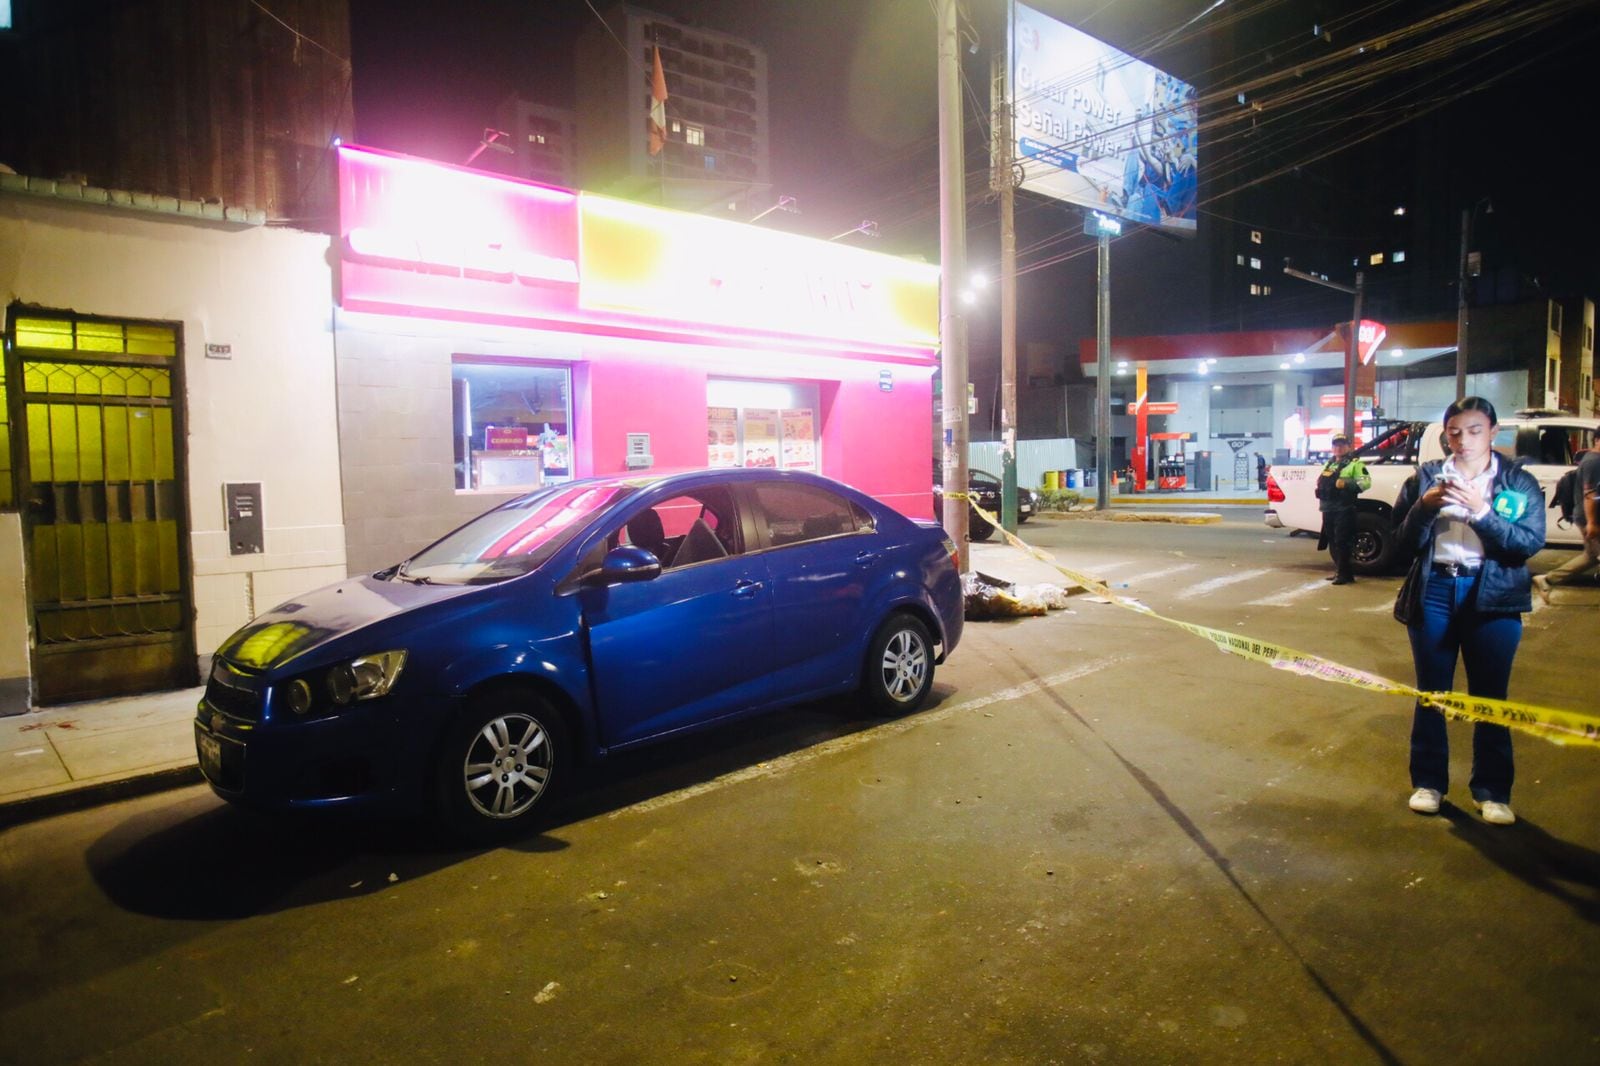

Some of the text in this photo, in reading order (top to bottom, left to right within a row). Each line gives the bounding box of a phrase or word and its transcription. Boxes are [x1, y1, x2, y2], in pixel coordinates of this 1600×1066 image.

[1018, 102, 1068, 141] Señal
[1072, 88, 1121, 125] Power
[1252, 643, 1261, 656] DEL
